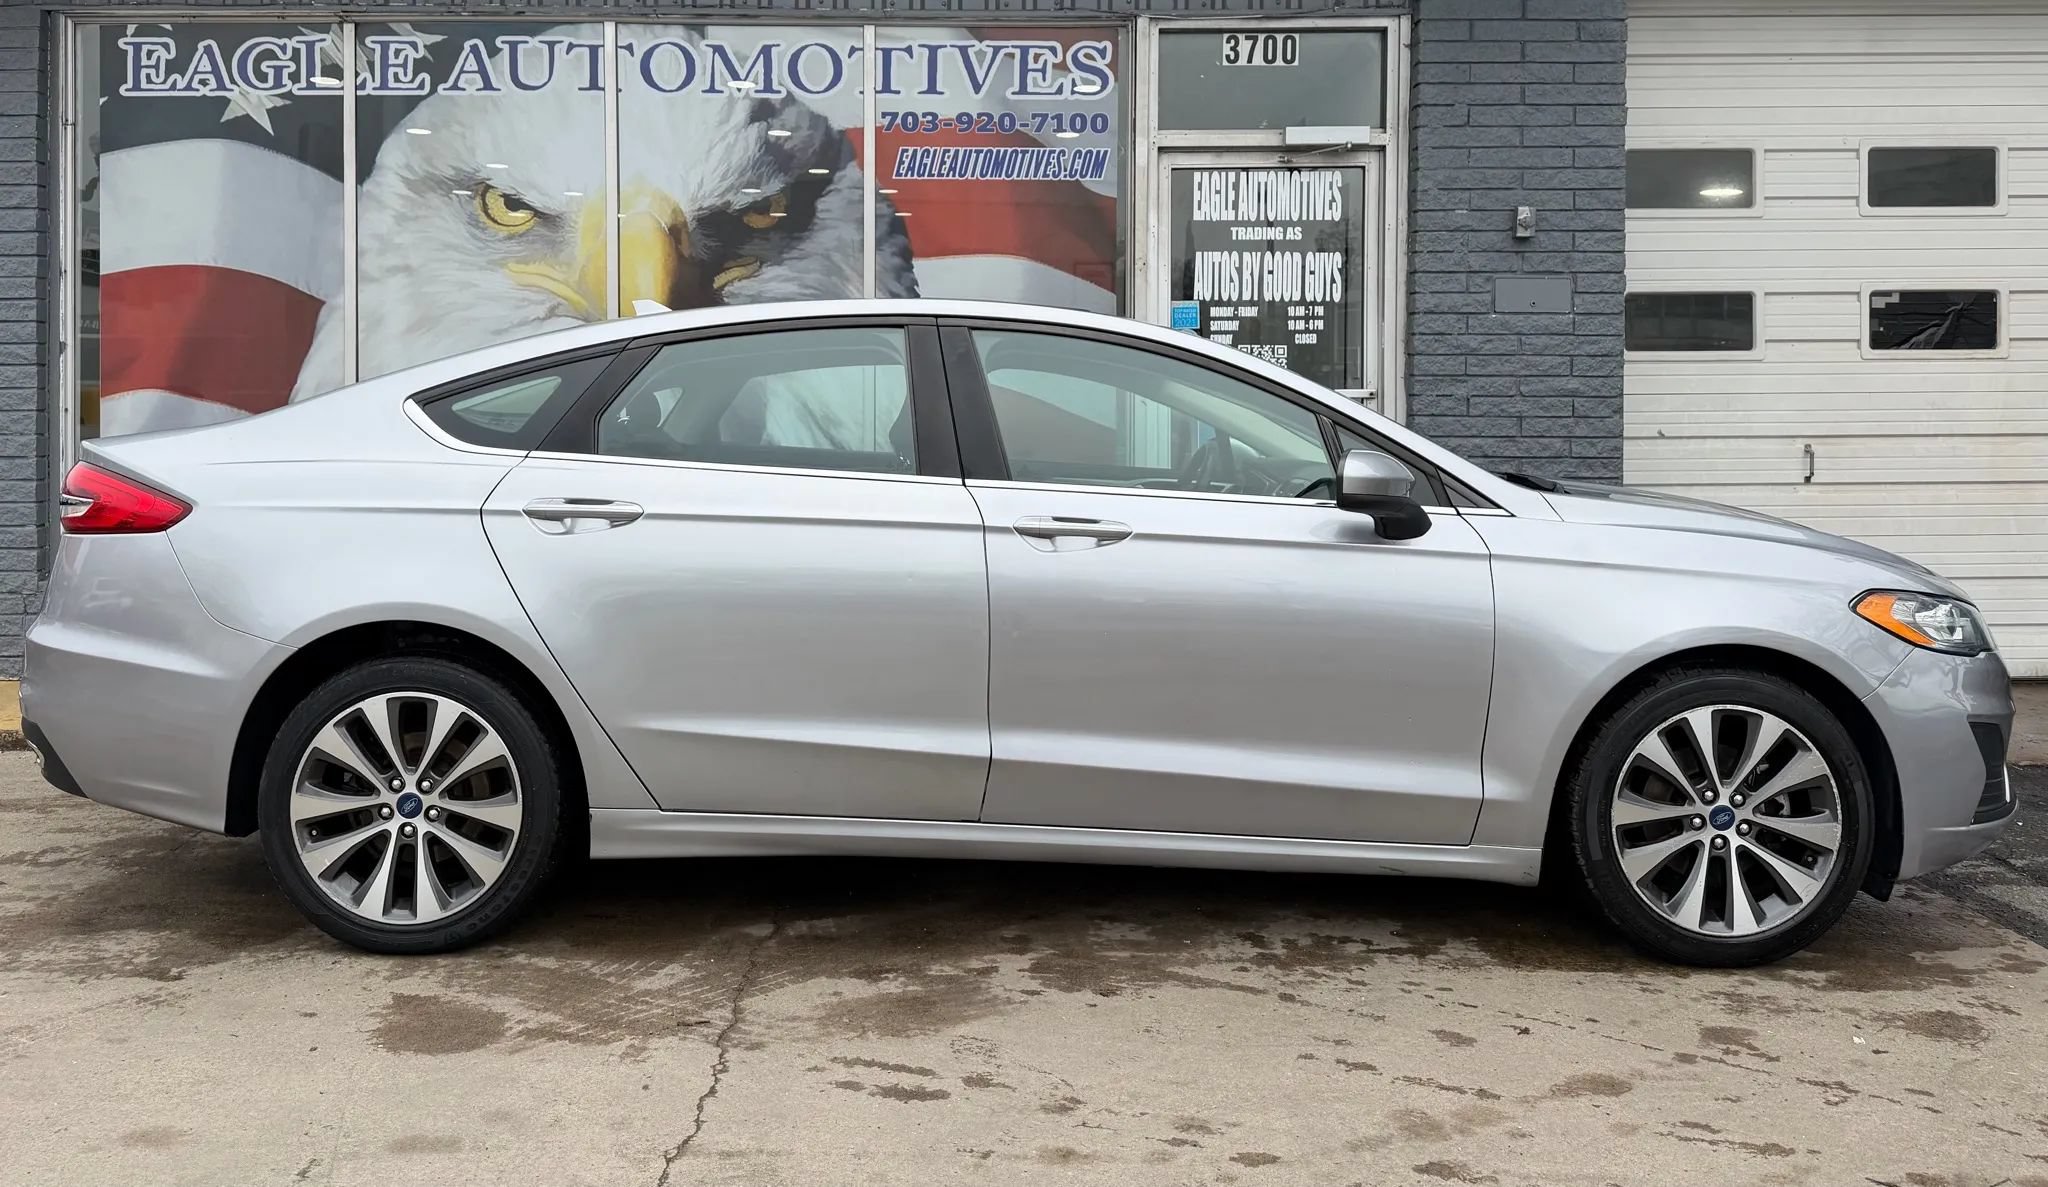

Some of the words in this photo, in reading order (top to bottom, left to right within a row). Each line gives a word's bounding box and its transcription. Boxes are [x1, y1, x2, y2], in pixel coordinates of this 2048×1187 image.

[1225, 34, 1297, 65] 3700
[118, 36, 431, 96] EAGLE
[438, 37, 1115, 101] AUTOMOTIVES
[881, 111, 1110, 135] 703-920-7100
[894, 148, 1110, 181] EAGLEAUTOMOTIVES.COM
[1193, 171, 1236, 221] EAGLE
[1238, 171, 1342, 221] AUTOMOTIVES
[1231, 227, 1283, 240] TRADING
[1286, 227, 1302, 240] AS
[1194, 251, 1239, 301] AUTOS
[1242, 252, 1261, 301] BY
[1263, 251, 1302, 302] GOOD
[1305, 252, 1342, 302] GUYS
[1210, 306, 1235, 317] MONDAY
[1238, 306, 1259, 317] FRIDAY
[1288, 306, 1295, 316] 10
[1295, 306, 1305, 316] AM
[1314, 306, 1324, 316] PM
[1210, 320, 1240, 331] SATURDAY
[1288, 320, 1295, 330] 10
[1295, 320, 1305, 330] AM
[1314, 320, 1324, 330] PM
[1295, 333, 1317, 344] CLOSED
